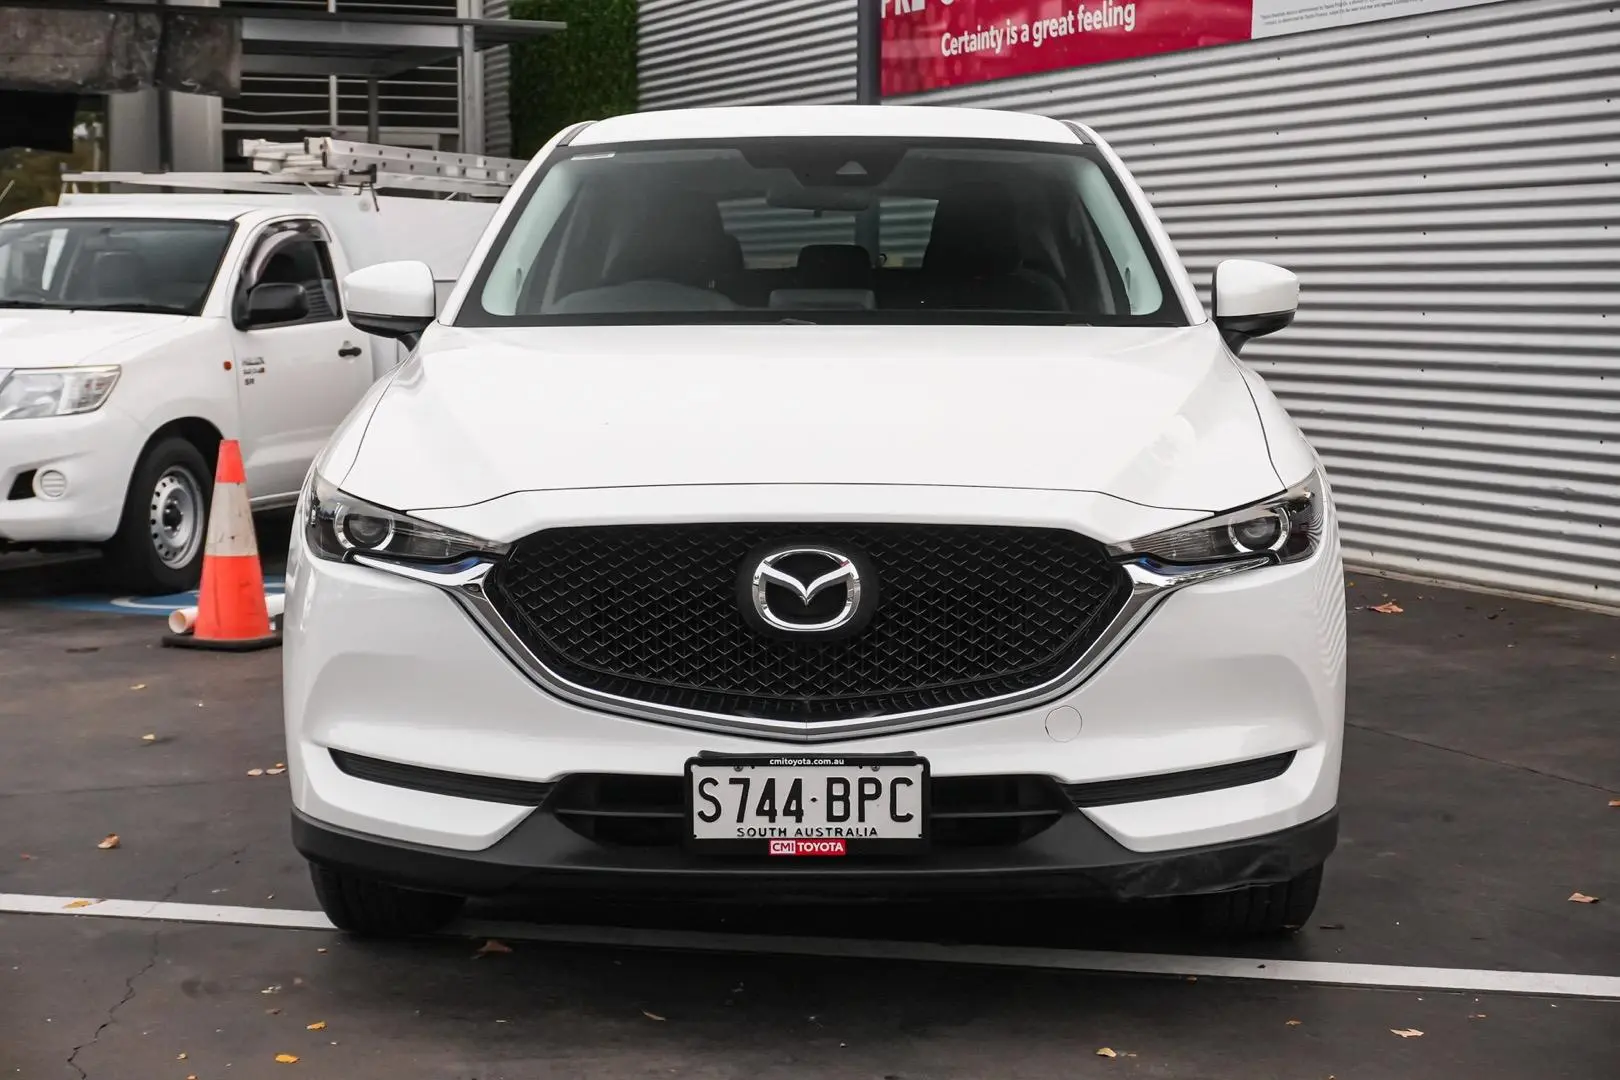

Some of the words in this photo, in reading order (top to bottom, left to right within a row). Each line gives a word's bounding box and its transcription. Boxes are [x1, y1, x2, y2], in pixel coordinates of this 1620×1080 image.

[941, 25, 1004, 57] Certainty
[1006, 19, 1018, 45] is
[1021, 27, 1029, 43] a
[1032, 11, 1075, 48] great
[1077, 1, 1136, 33] feeling
[769, 758, 845, 767] cmitoyota.com.au
[736, 827, 787, 838] SOUTH
[794, 827, 878, 838] AUSTRALIA
[772, 842, 794, 853] CMI
[797, 842, 844, 853] TOYOTA
